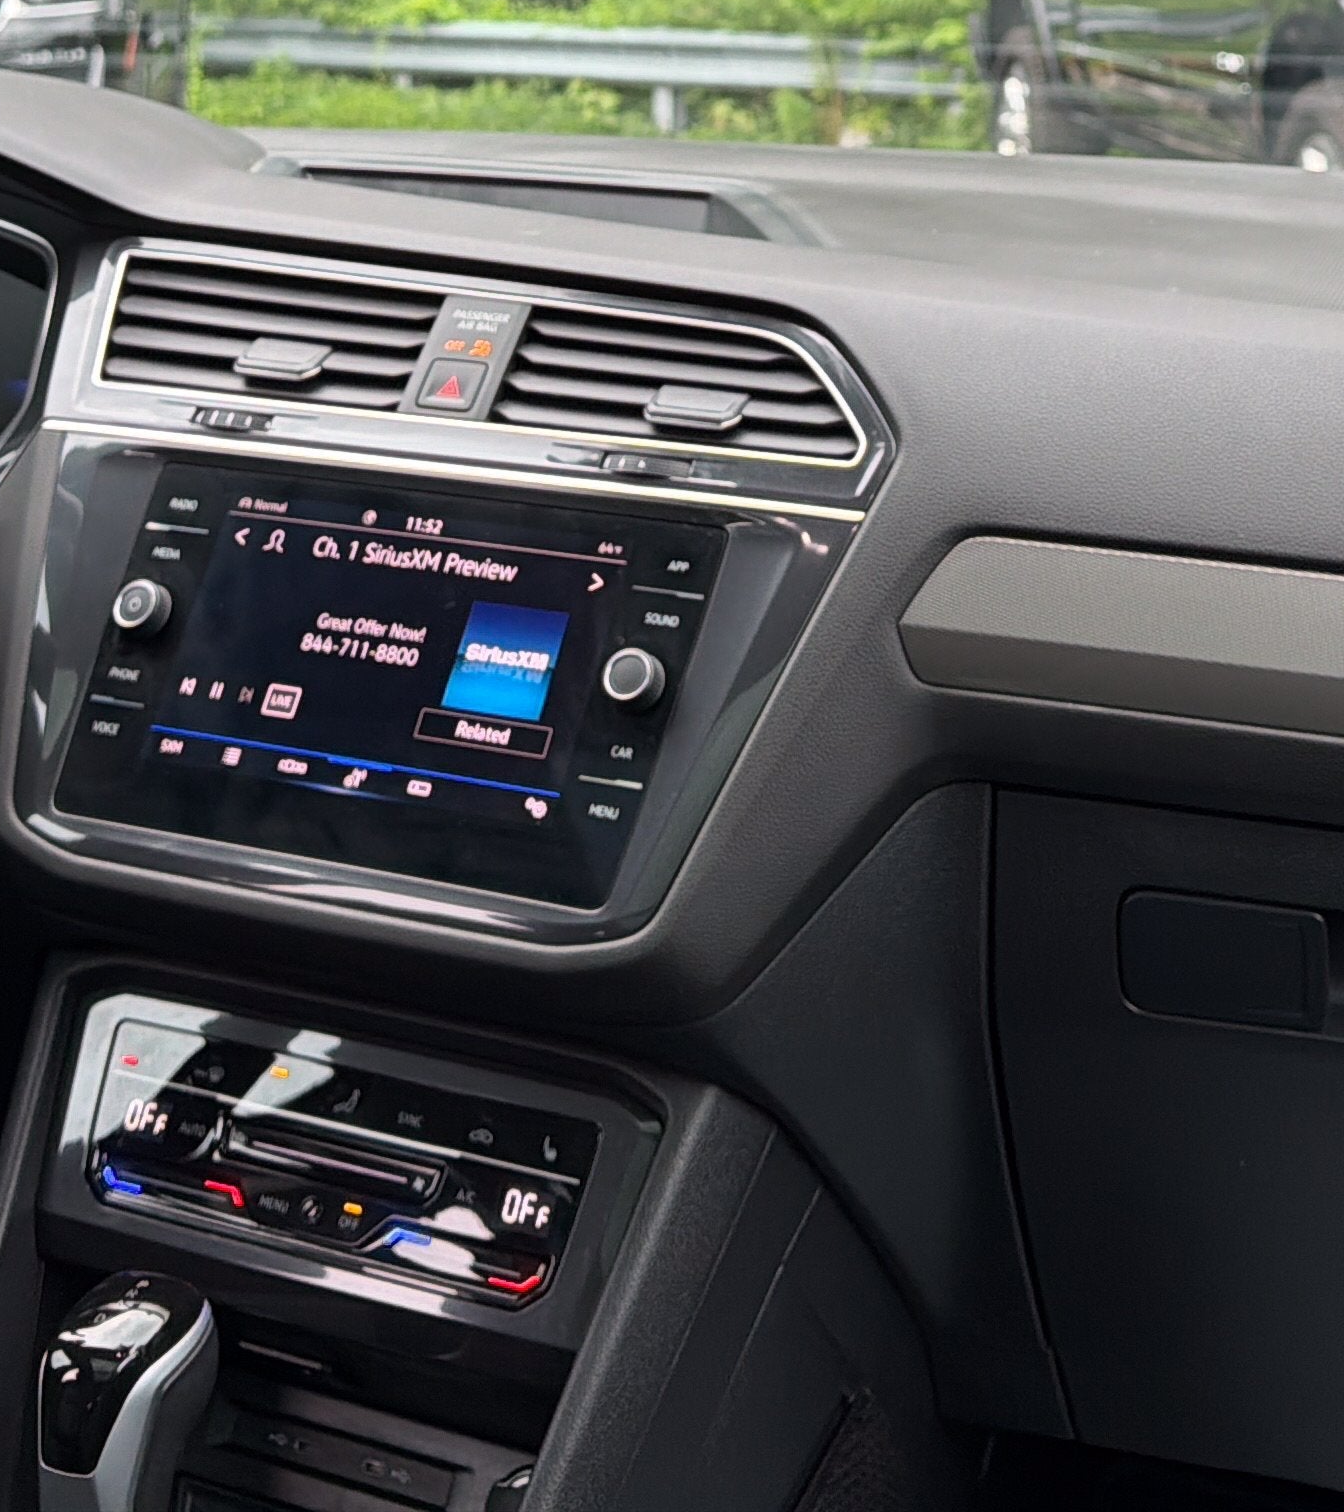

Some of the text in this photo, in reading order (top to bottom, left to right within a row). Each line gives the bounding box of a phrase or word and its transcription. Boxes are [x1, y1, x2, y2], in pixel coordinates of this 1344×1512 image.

[405, 516, 443, 536] 11:52
[312, 535, 518, 583] Ch. 1 SiriusXM Preview
[666, 559, 690, 573] APP
[316, 612, 427, 644] Great Offer Now!
[643, 611, 680, 629] SOUND
[300, 632, 420, 668] 844-711-8800
[464, 642, 550, 672] SiriusXM
[107, 665, 141, 683] PHONE
[91, 719, 121, 737] VOICE
[454, 719, 512, 746] Related
[610, 744, 634, 761] CAR
[588, 803, 621, 821] MENU
